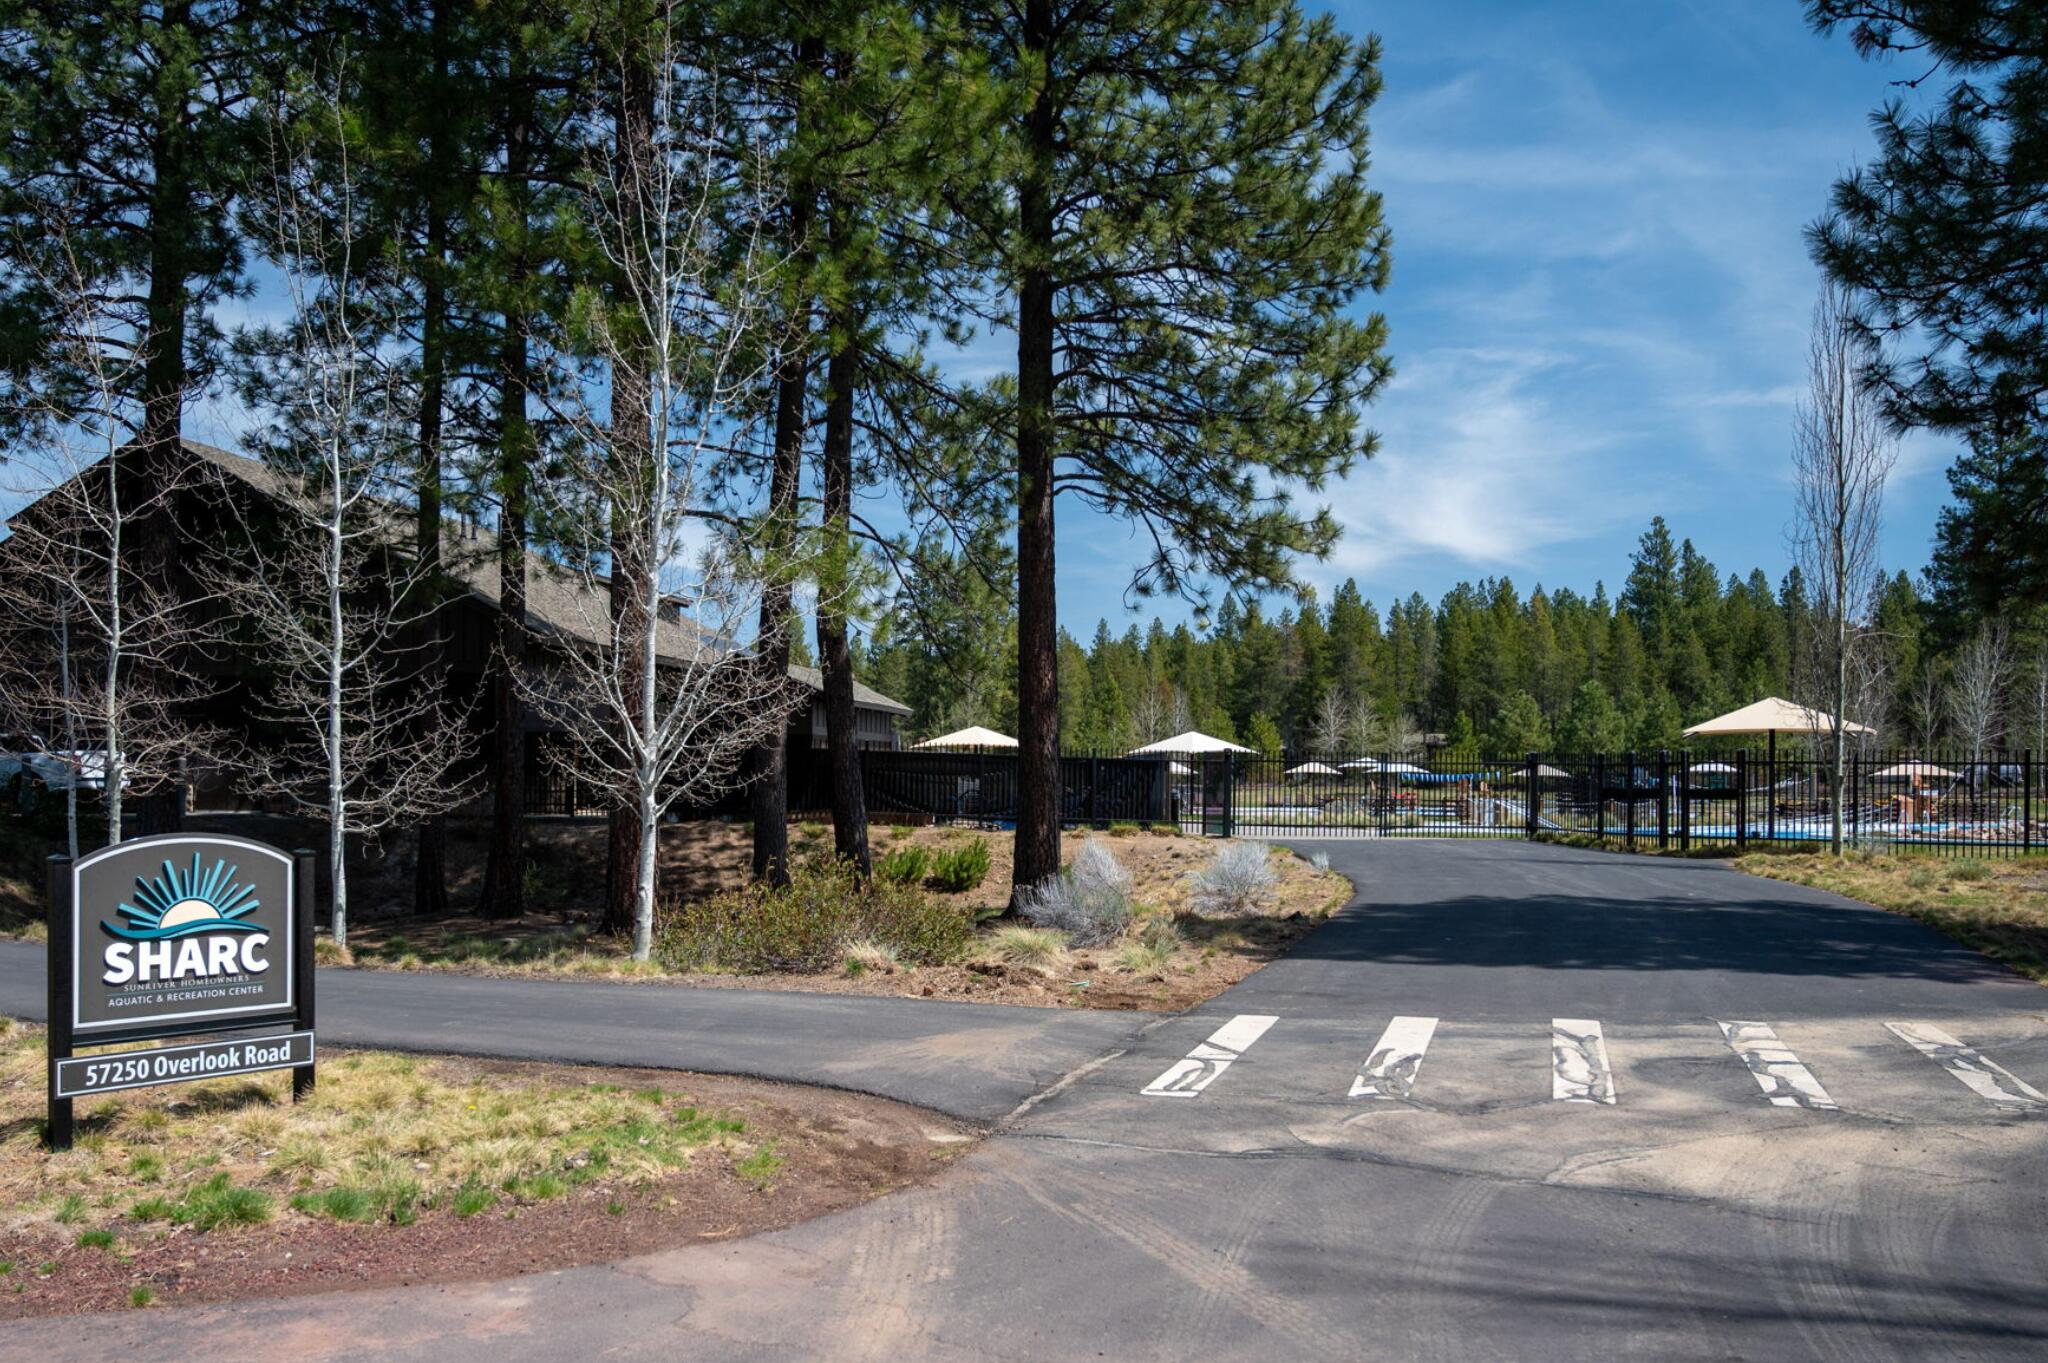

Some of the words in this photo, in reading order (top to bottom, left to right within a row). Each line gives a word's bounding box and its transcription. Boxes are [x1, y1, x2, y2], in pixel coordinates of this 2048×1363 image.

[103, 934, 270, 984] SHARC
[108, 994, 152, 1007] AQUATIC
[156, 993, 163, 1003] &
[167, 989, 225, 1001] RECREATION
[229, 985, 264, 996] CENTER
[124, 981, 176, 992] SUNRIVER
[180, 975, 250, 987] HOMEOWNERS
[86, 1058, 149, 1086] 57250
[154, 1047, 240, 1075] Overlook
[245, 1040, 291, 1066] Road
